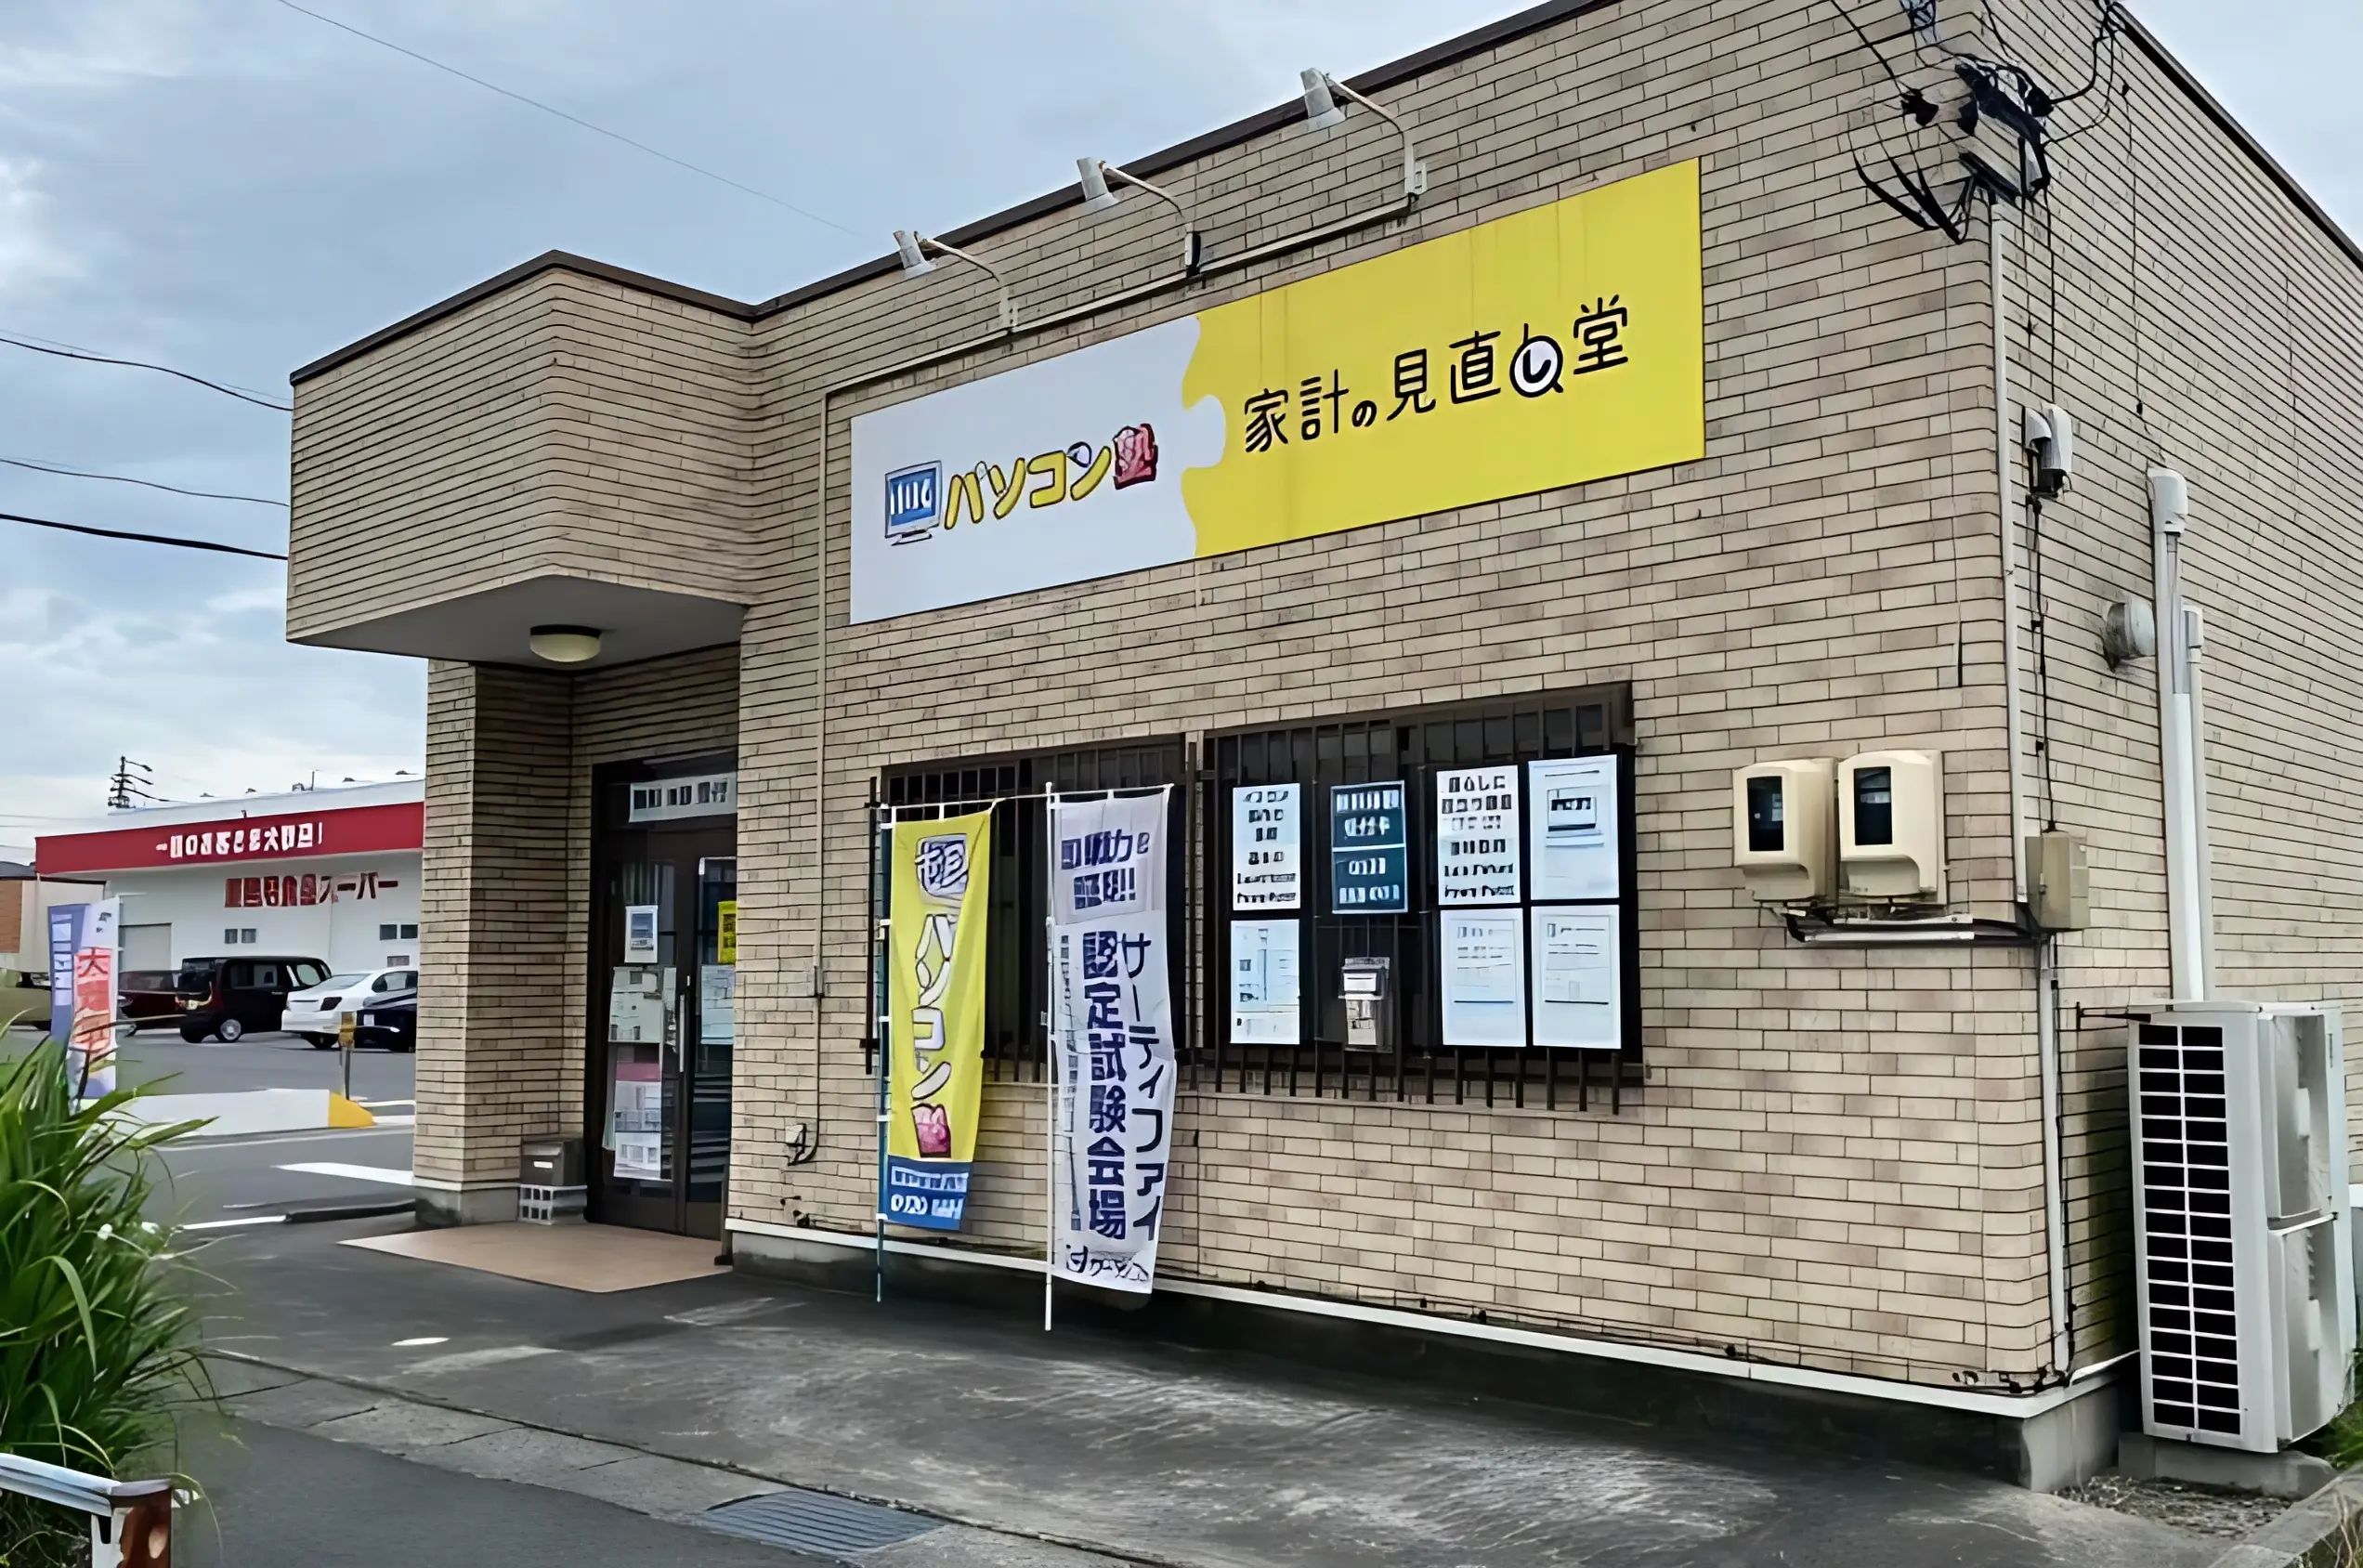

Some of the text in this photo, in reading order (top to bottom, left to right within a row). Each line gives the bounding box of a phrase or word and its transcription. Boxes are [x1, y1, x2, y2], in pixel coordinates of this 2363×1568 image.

[1244, 294, 1629, 453] 家計の見直し堂
[1121, 932, 1166, 1241] サーティファイ
